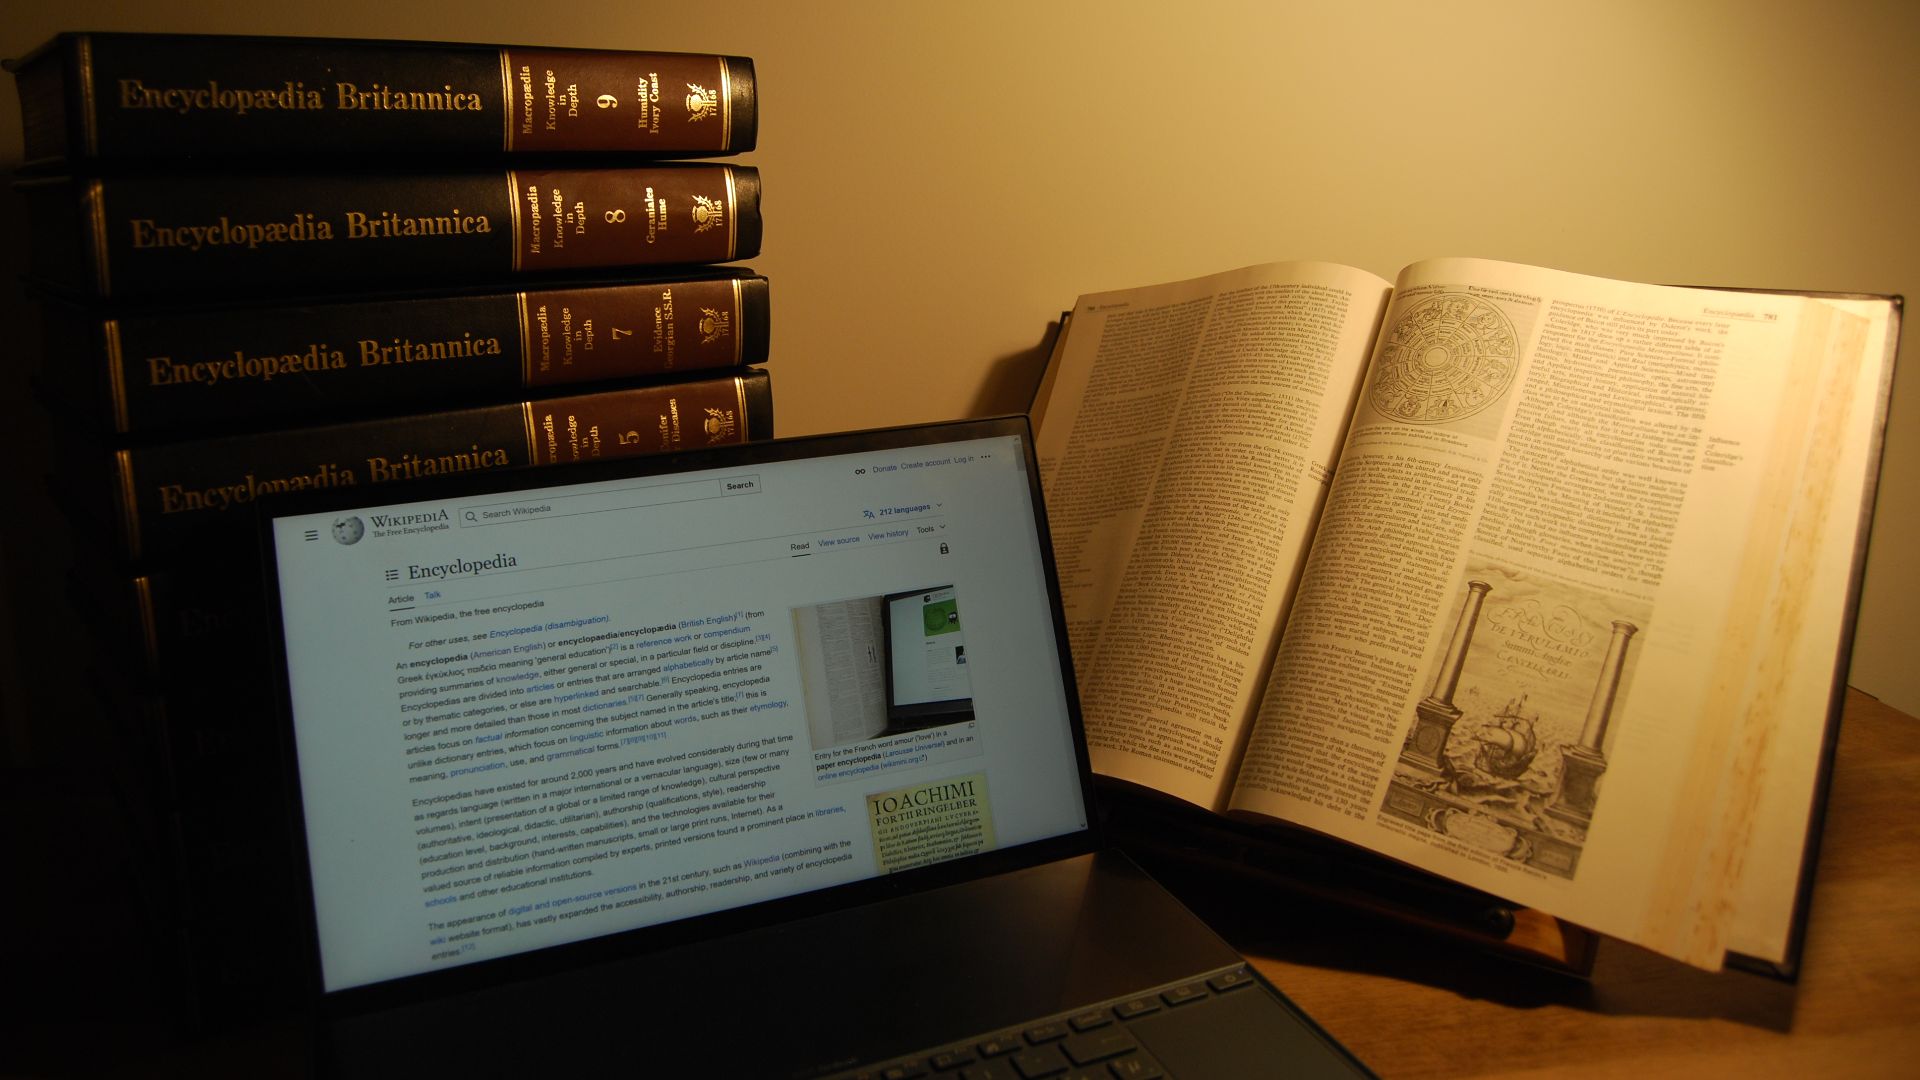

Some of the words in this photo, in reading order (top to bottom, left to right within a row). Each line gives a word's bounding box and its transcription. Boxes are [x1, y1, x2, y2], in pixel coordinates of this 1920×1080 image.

[118, 79, 324, 116] Encyclopædia
[337, 82, 483, 112] Britannica
[520, 66, 534, 134] Macropædia
[545, 70, 556, 130] Knowledge
[558, 95, 567, 105] in
[568, 84, 579, 117] Depth
[596, 94, 618, 109] 9
[638, 77, 649, 128] Humidity
[650, 73, 660, 102] Coast
[650, 106, 661, 134] Ivory
[528, 186, 540, 253] Macropædia
[553, 189, 563, 248] Knowledge
[565, 213, 574, 224] in
[575, 202, 585, 234] Depth
[605, 209, 626, 223] 8
[645, 187, 656, 243] Geraniales
[658, 198, 667, 230] Hume
[132, 214, 334, 250] Encyclopædia
[346, 209, 492, 240] Britannica
[663, 289, 673, 320] S.S.R.
[537, 306, 550, 371] Macropædia
[562, 308, 573, 365] Knowledge
[574, 331, 582, 340] in
[584, 319, 594, 350] Depth
[612, 328, 632, 340] 7
[653, 307, 663, 352] Evidence
[146, 344, 347, 386] Encyclopædia
[358, 332, 502, 367] Britannica
[663, 323, 675, 369] Georgian
[668, 398, 680, 442] Diseases
[543, 414, 557, 464] cropædia
[582, 438, 589, 448] in
[590, 426, 600, 456] Depth
[619, 431, 640, 445] 5
[367, 444, 510, 482] Britannica
[872, 465, 897, 473] Donate
[900, 461, 923, 469] Create
[924, 458, 951, 466] account
[726, 480, 753, 490] Search
[370, 508, 448, 528] WIKIPEDIA
[482, 509, 510, 518] Search
[512, 504, 550, 515] Wikipedia
[893, 504, 930, 513] languages
[403, 522, 449, 534] Encyclopedia
[836, 536, 859, 544] source
[886, 529, 908, 537] history
[790, 542, 809, 550] Read
[408, 553, 516, 579] Encyclopedia
[387, 594, 414, 604] Article
[414, 612, 454, 623] Wikipedia,
[492, 600, 544, 613] encyclopedia
[408, 641, 422, 649] For
[424, 638, 446, 647] other
[448, 636, 469, 644] uses,
[489, 624, 542, 638] Encyclopedia
[544, 615, 608, 632] (disambiguation).
[409, 653, 468, 667] encyclopedia
[470, 648, 511, 660] (American
[513, 641, 546, 652] English)
[557, 623, 676, 646] encyclopaedia/encyclopædia
[1369, 640, 1399, 652] preferred
[411, 791, 472, 806] Encyclopedias
[474, 787, 494, 795] have
[496, 780, 525, 792] existed
[540, 773, 568, 784] around
[570, 768, 593, 779] 2,000
[595, 766, 616, 776] years
[618, 761, 633, 771] and
[635, 759, 654, 767] have
[656, 752, 686, 764] evolved
[687, 744, 734, 758] considerably
[736, 740, 760, 749] during
[761, 736, 775, 745] that
[816, 762, 835, 772] paper
[836, 753, 881, 766] encyclopedia
[872, 780, 974, 815] IOACHIMI
[446, 912, 496, 928] appearance
[497, 908, 506, 917] of
[508, 904, 532, 915] digital
[534, 900, 550, 910] and
[551, 891, 602, 906] open-source
[604, 884, 637, 895] versions
[662, 874, 679, 884] 21st
[680, 869, 711, 880] century,
[712, 864, 731, 874] such
[743, 854, 779, 867] Wikipedia
[781, 846, 821, 861] (combining
[822, 842, 838, 850] with
